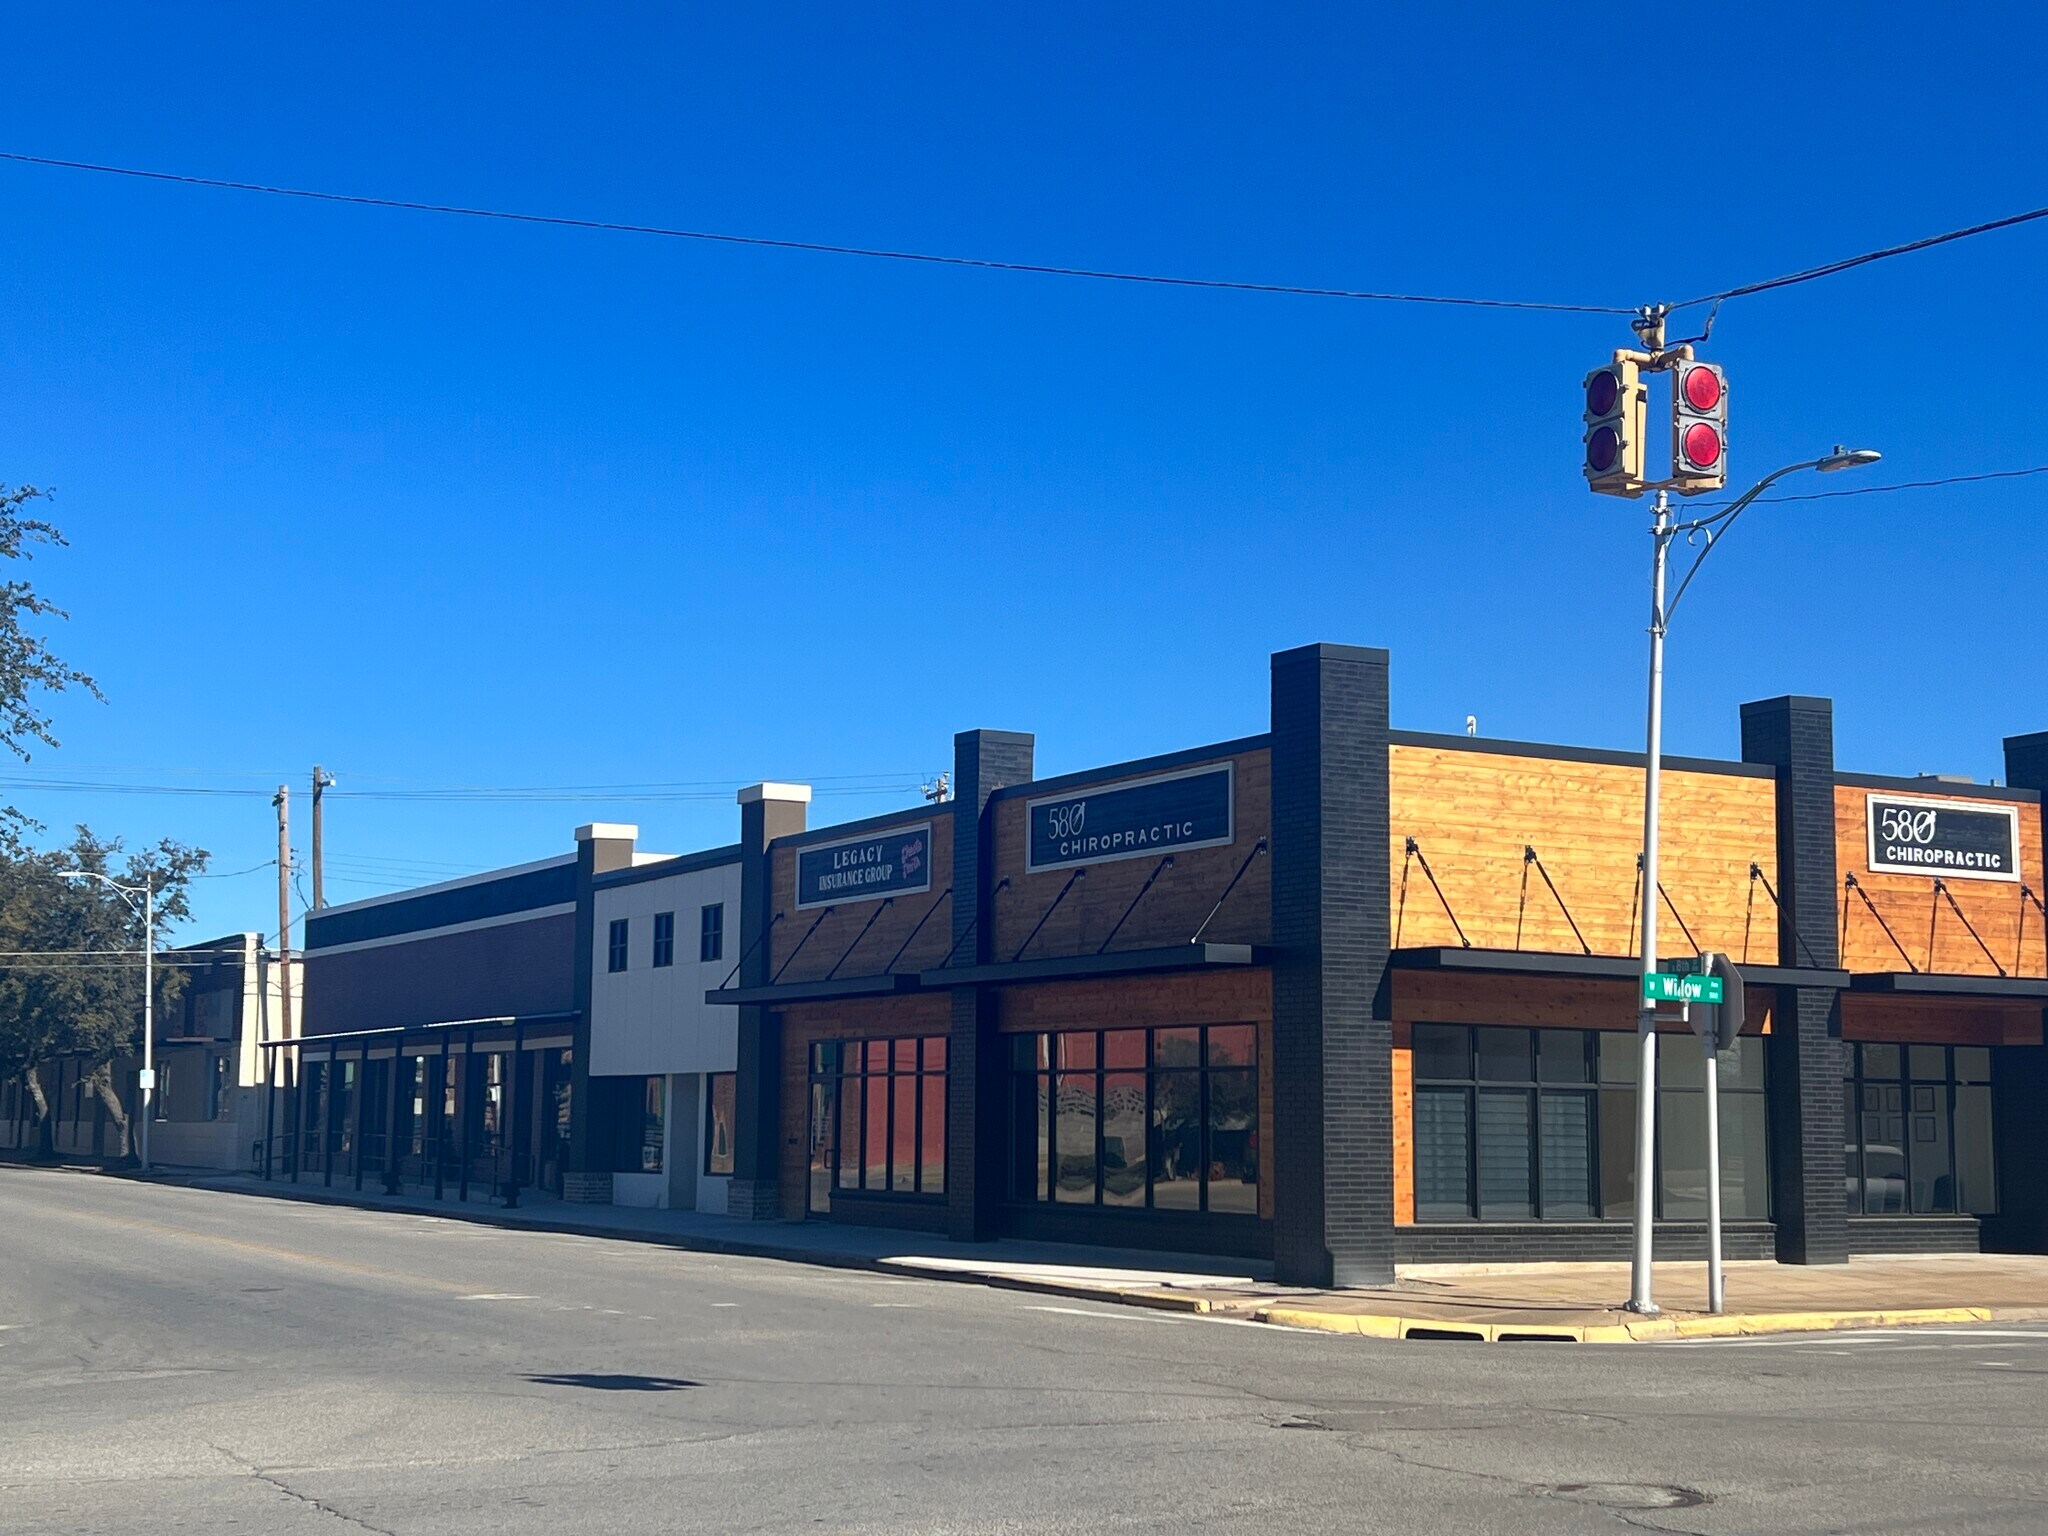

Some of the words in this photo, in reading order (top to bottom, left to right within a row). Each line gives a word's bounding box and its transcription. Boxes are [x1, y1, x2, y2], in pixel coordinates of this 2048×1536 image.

[1048, 801, 1086, 840] 580
[1881, 808, 1937, 844] 580
[1060, 821, 1193, 855] CHIROPRACTIC
[833, 844, 884, 869] LEGACY
[1886, 845, 2001, 868] CHIROPRACTIC
[818, 868, 863, 891] INSURANCE
[864, 864, 893, 885] GROUP
